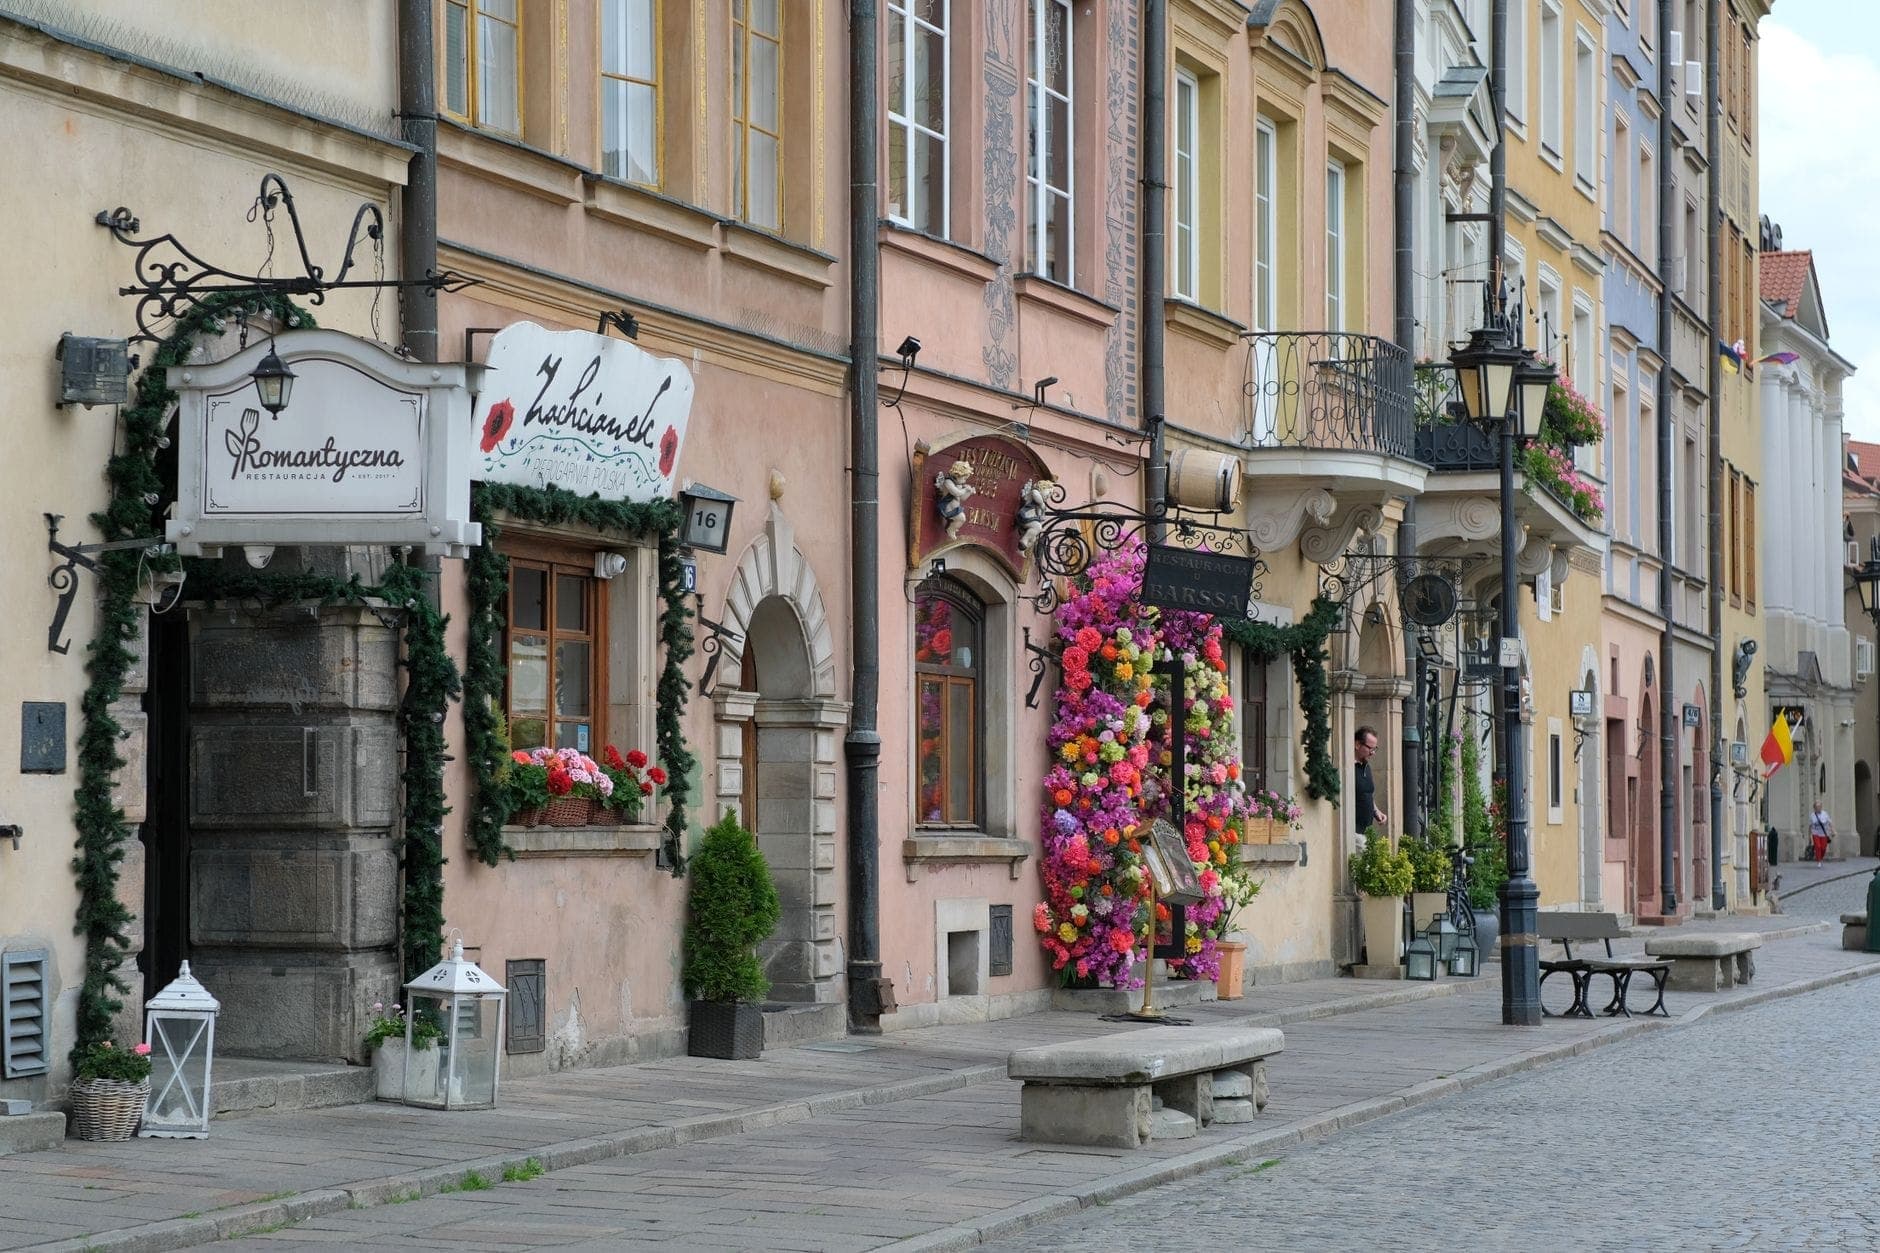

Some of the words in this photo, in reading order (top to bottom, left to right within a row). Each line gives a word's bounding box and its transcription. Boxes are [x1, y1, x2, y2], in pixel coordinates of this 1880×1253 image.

[241, 436, 405, 483] Romantyczna
[531, 458, 590, 485] PIEROGARNIA
[592, 463, 628, 491] POLSKA
[695, 510, 717, 528] 16
[685, 566, 694, 589] 16
[1152, 555, 1248, 577] RESTAURACJA
[1151, 584, 1241, 611] BARSSA
